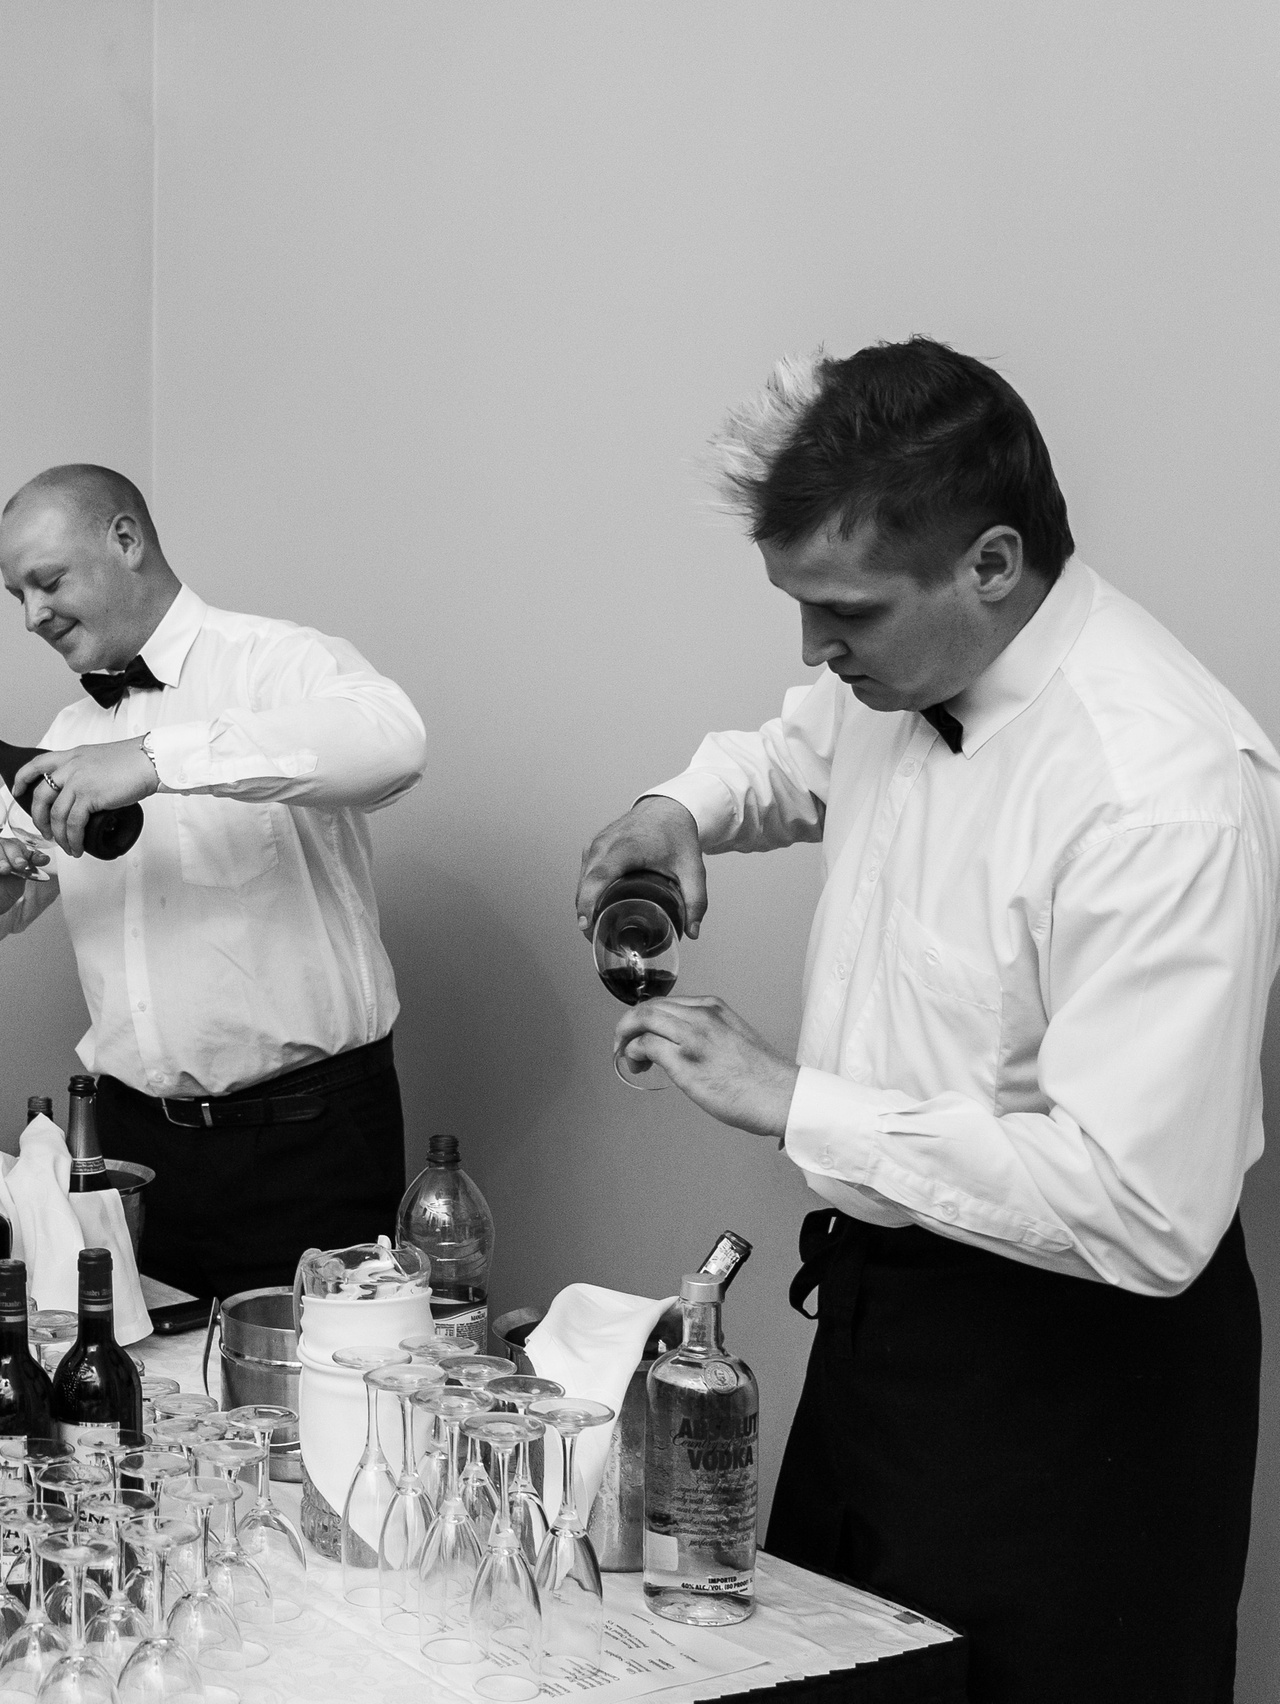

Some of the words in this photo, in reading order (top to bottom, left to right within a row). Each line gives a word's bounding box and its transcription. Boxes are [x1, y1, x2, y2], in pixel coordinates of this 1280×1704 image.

[678, 1412, 758, 1441] ABSOLUT
[687, 1445, 753, 1471] VODKA
[708, 1576, 737, 1584] IMPORTED
